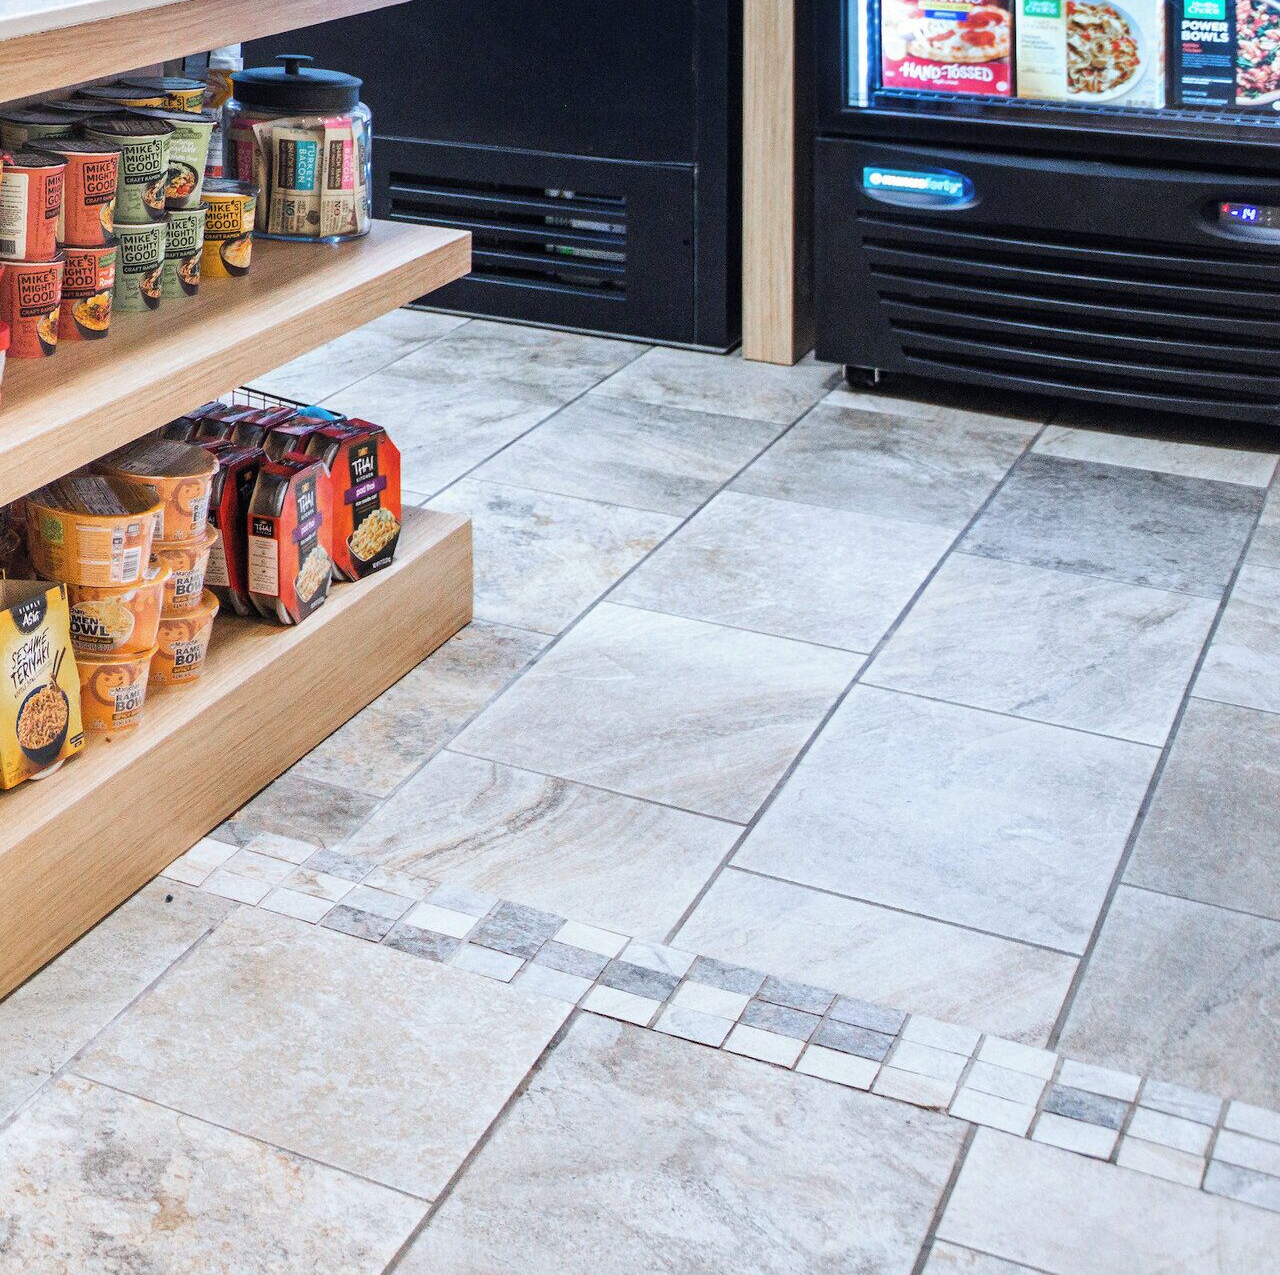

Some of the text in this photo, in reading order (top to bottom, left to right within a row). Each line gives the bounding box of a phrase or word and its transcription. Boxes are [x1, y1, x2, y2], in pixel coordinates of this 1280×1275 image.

[1181, 20, 1228, 32] POWER
[1181, 31, 1229, 43] BOWLS
[125, 143, 161, 155] MIKE'S
[126, 153, 161, 164] MIGHTY
[85, 159, 117, 173] MIKE'S
[127, 161, 160, 173] GOOD
[86, 171, 116, 183] MIGHTY
[87, 180, 117, 193] GOOD
[206, 211, 239, 221] MIGHTY
[206, 220, 239, 229] GOOD
[123, 235, 159, 246] MIKE'S
[124, 243, 158, 254] MIGHTY
[124, 251, 158, 264] GOOD
[19, 271, 57, 285] MIKE'S
[20, 282, 57, 295] MIGHTY
[21, 292, 56, 306] GOOD
[352, 455, 374, 475] THAI
[255, 524, 272, 532] THAI
[18, 600, 41, 613] SIMPLY
[12, 627, 50, 669] SESAME
[11, 642, 50, 689] TERIYAKI
